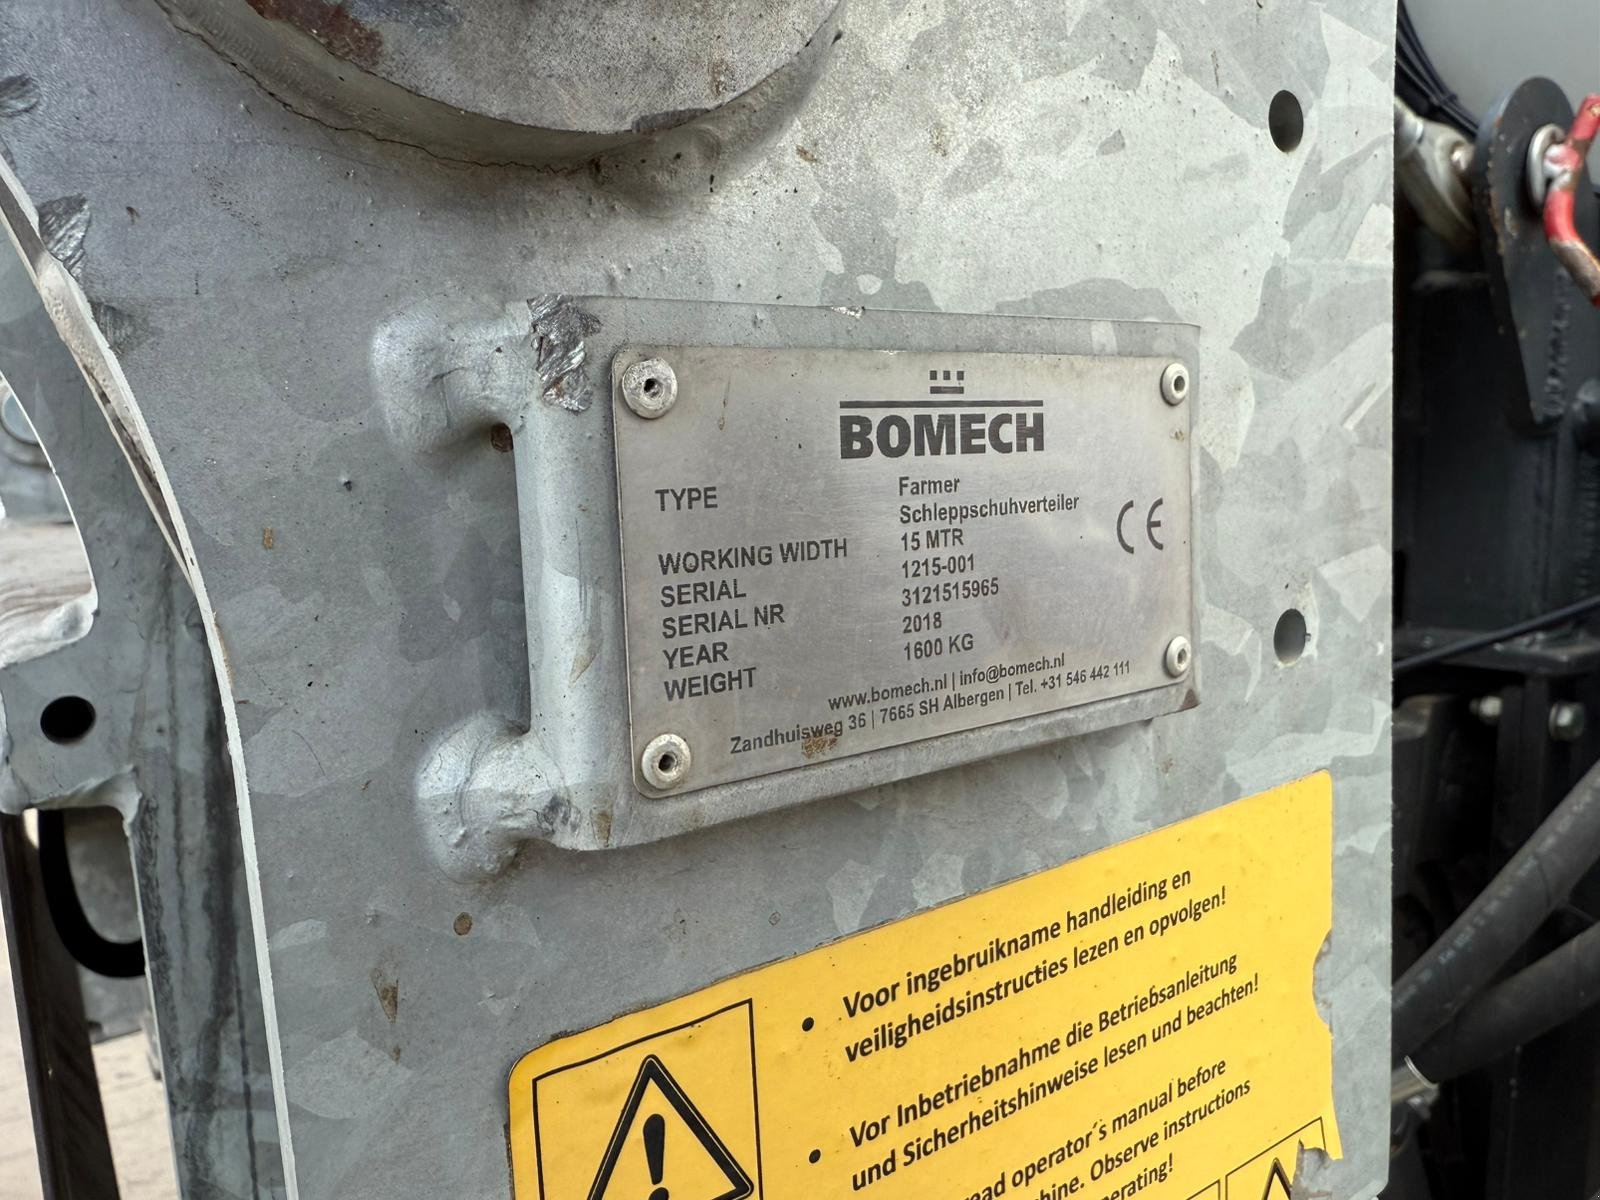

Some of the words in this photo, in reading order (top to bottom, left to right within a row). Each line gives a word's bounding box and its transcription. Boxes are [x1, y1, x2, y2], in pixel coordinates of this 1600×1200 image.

[840, 413, 1044, 459] BOMECH
[655, 486, 718, 512] TYPE
[899, 476, 960, 496] Farmer
[900, 494, 1080, 525] Schleppschuhverteiler
[658, 546, 773, 575] WORKING
[779, 538, 847, 563] WIDTH
[901, 531, 920, 551] 15
[926, 528, 964, 550] MTR
[902, 553, 975, 578] 1215-001
[660, 579, 747, 608] SERIAL
[902, 577, 999, 607] 3121515965
[662, 609, 748, 639] SERIAL
[754, 603, 785, 627] NR
[903, 612, 942, 634] 2018
[663, 641, 729, 670] YEAR
[904, 639, 943, 661] 1600
[949, 633, 974, 654] KG
[664, 667, 757, 701] WEIGHT
[828, 673, 947, 710] www.bomech.nl
[960, 652, 1065, 686] info@bomech.nl
[730, 720, 843, 754] Zandhuisweg
[848, 712, 866, 730] 36
[880, 703, 914, 724] 7665
[919, 697, 939, 716] SH
[942, 686, 1004, 710] Albergen
[1015, 679, 1037, 696] Tel.
[1041, 675, 1061, 691] +31
[1066, 669, 1087, 687] 546
[1089, 665, 1109, 681] 442
[1113, 660, 1130, 677] 111
[842, 981, 900, 1018] Voor
[906, 921, 1060, 995] ingebruikname
[1066, 879, 1167, 933] handleiding
[1171, 870, 1191, 890] en
[845, 956, 1068, 1062] veiligheidsinstructies
[1073, 936, 1118, 968] lezen
[1124, 925, 1144, 946] en
[1150, 885, 1226, 937] opvolgen!
[849, 1114, 891, 1148] Vor
[897, 1037, 1060, 1127] Inbetriebnahme
[1066, 1020, 1093, 1047] die
[1099, 954, 1237, 1032] Betriebsanleitung
[852, 1148, 896, 1191] und
[903, 1057, 1098, 1167] Sicherheitshinweise
[1104, 1033, 1147, 1067] lesen
[1152, 1010, 1182, 1042] und
[1187, 972, 1258, 1025] beachten!
[965, 1171, 1005, 1200] ad
[1112, 1082, 1172, 1133] manual
[1177, 1059, 1226, 1098] before
[1036, 1176, 1084, 1200] hine.
[1090, 1132, 1159, 1181] Observe
[1164, 1079, 1250, 1140] instructions
[1102, 1152, 1173, 1200] erating!
